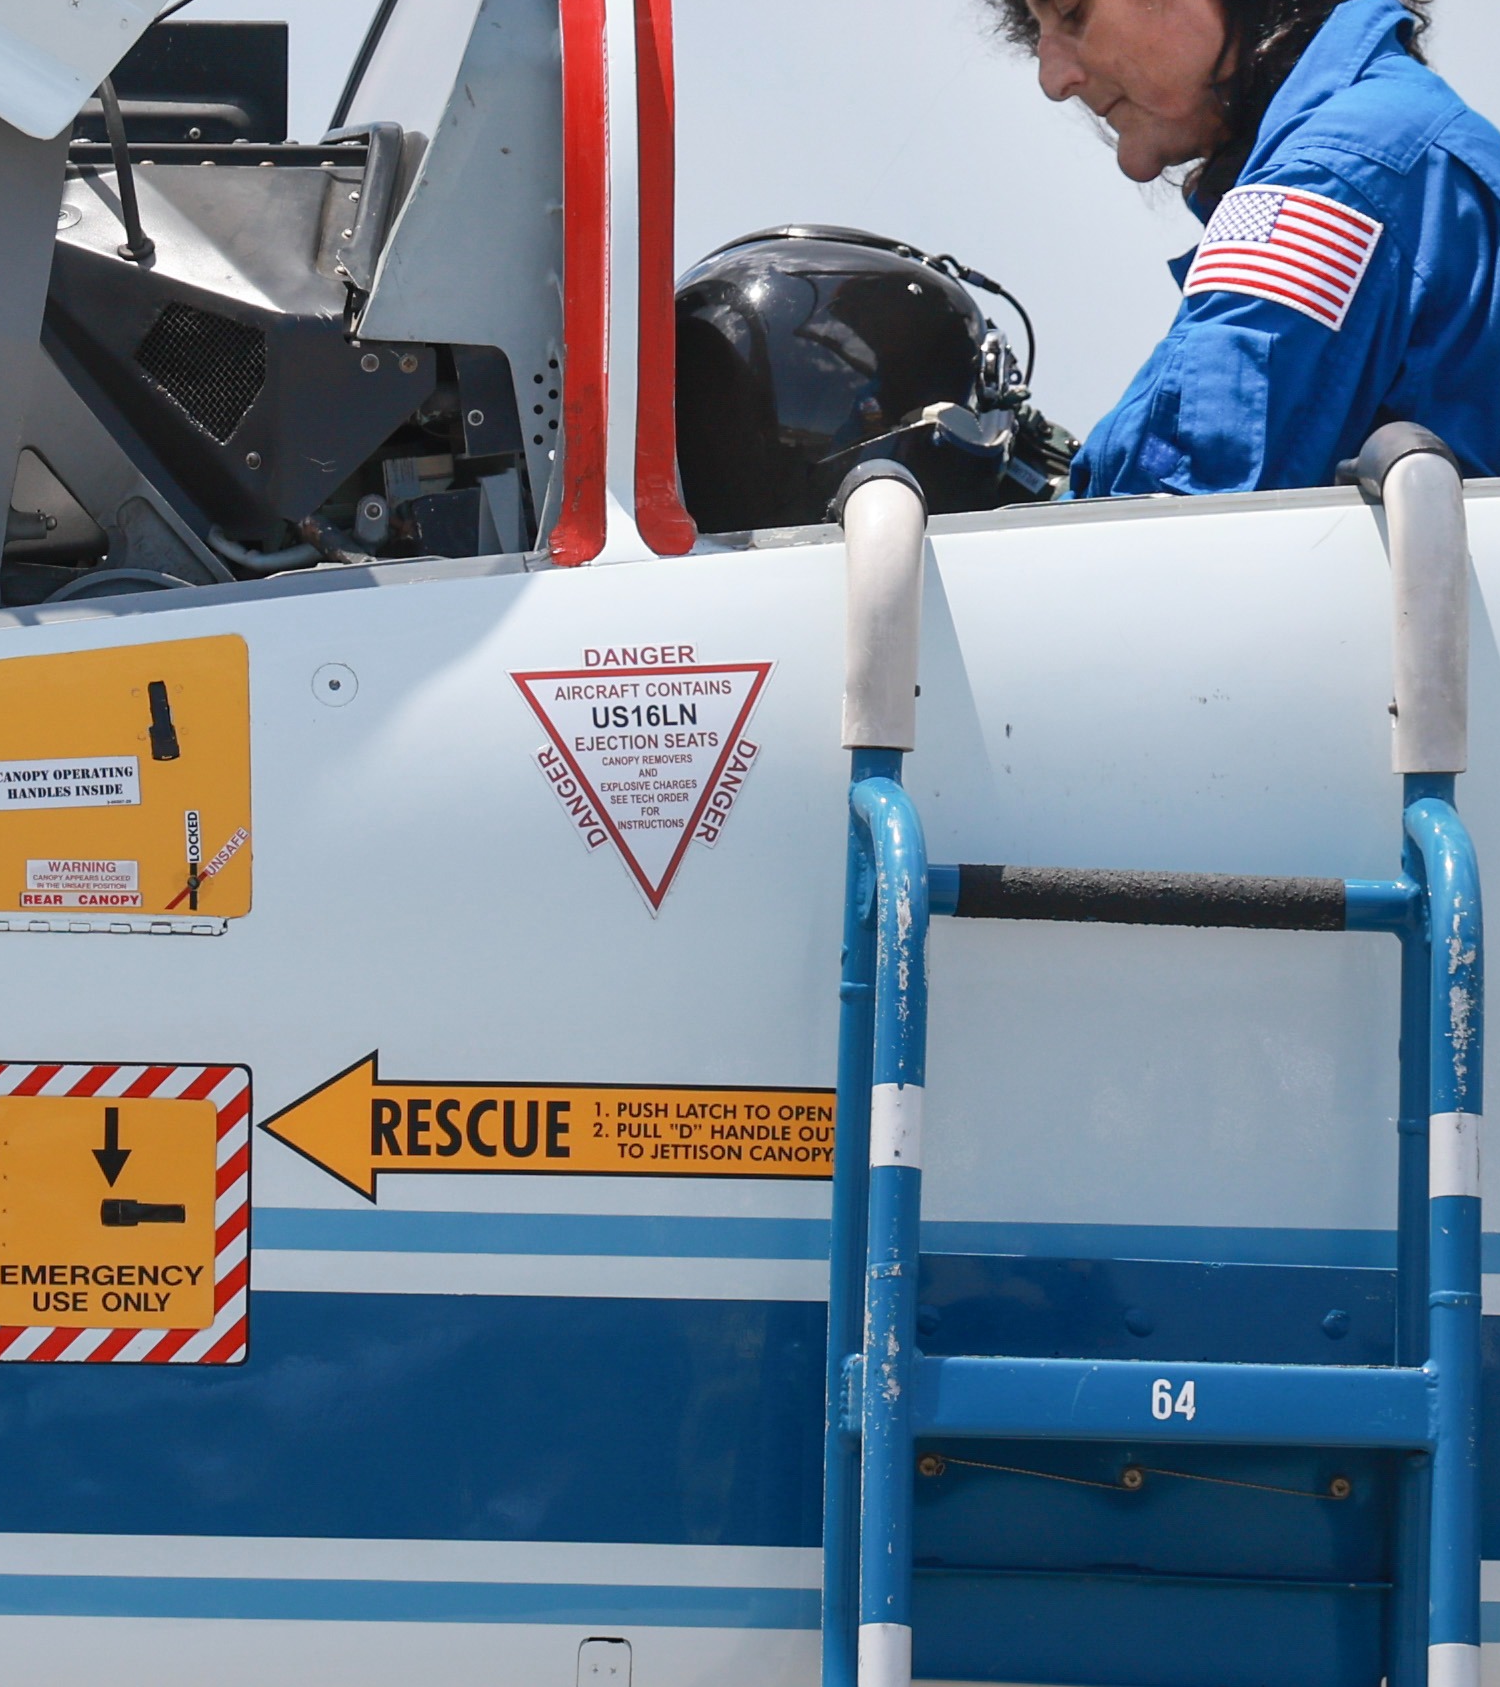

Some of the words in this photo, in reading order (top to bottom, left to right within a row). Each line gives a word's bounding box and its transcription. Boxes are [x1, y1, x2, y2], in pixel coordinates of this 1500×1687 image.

[584, 645, 695, 666] DANGER
[555, 683, 640, 700] AIRCRAFT
[646, 680, 732, 698] CONTAINS
[592, 703, 697, 728] US16LN
[575, 734, 659, 752] EJECTION
[664, 732, 718, 748] SEATS
[602, 756, 640, 766] CANOPY
[642, 754, 692, 764] REMOVERS
[53, 766, 133, 781] OPERATING
[639, 768, 658, 777] AND
[8, 786, 71, 799] HANDLES
[76, 784, 123, 797] INSIDE
[601, 782, 650, 792] EXPLOSIVE
[653, 780, 697, 790] CHARGES
[696, 740, 758, 843] DANGER
[538, 746, 608, 848] DANGER
[610, 795, 628, 804] SEE
[630, 794, 654, 803] TECH
[657, 793, 688, 802] ORDER
[641, 807, 660, 816] FOR
[618, 819, 684, 830] INSTRUCTIONS
[188, 812, 200, 862] LOCKED
[206, 829, 248, 876] UNSAFE
[48, 862, 116, 872] WARNING
[24, 894, 63, 905] REAR
[78, 894, 140, 905] CANOPY
[594, 1102, 610, 1118] 1.
[617, 1102, 668, 1118] PUSH
[676, 1104, 737, 1119] LATCH
[744, 1104, 770, 1120] TO
[778, 1106, 832, 1122] OPEN
[371, 1098, 571, 1158] RESCUE
[593, 1123, 610, 1138] 2.
[617, 1123, 662, 1138] PULL
[710, 1125, 791, 1141] HANDLE
[618, 1144, 644, 1159] TO
[651, 1144, 742, 1160] JETTISON
[0, 1264, 204, 1286] EMERGENCY
[33, 1291, 88, 1312] USE
[102, 1291, 171, 1312] ONLY
[1151, 1378, 1196, 1421] 64
